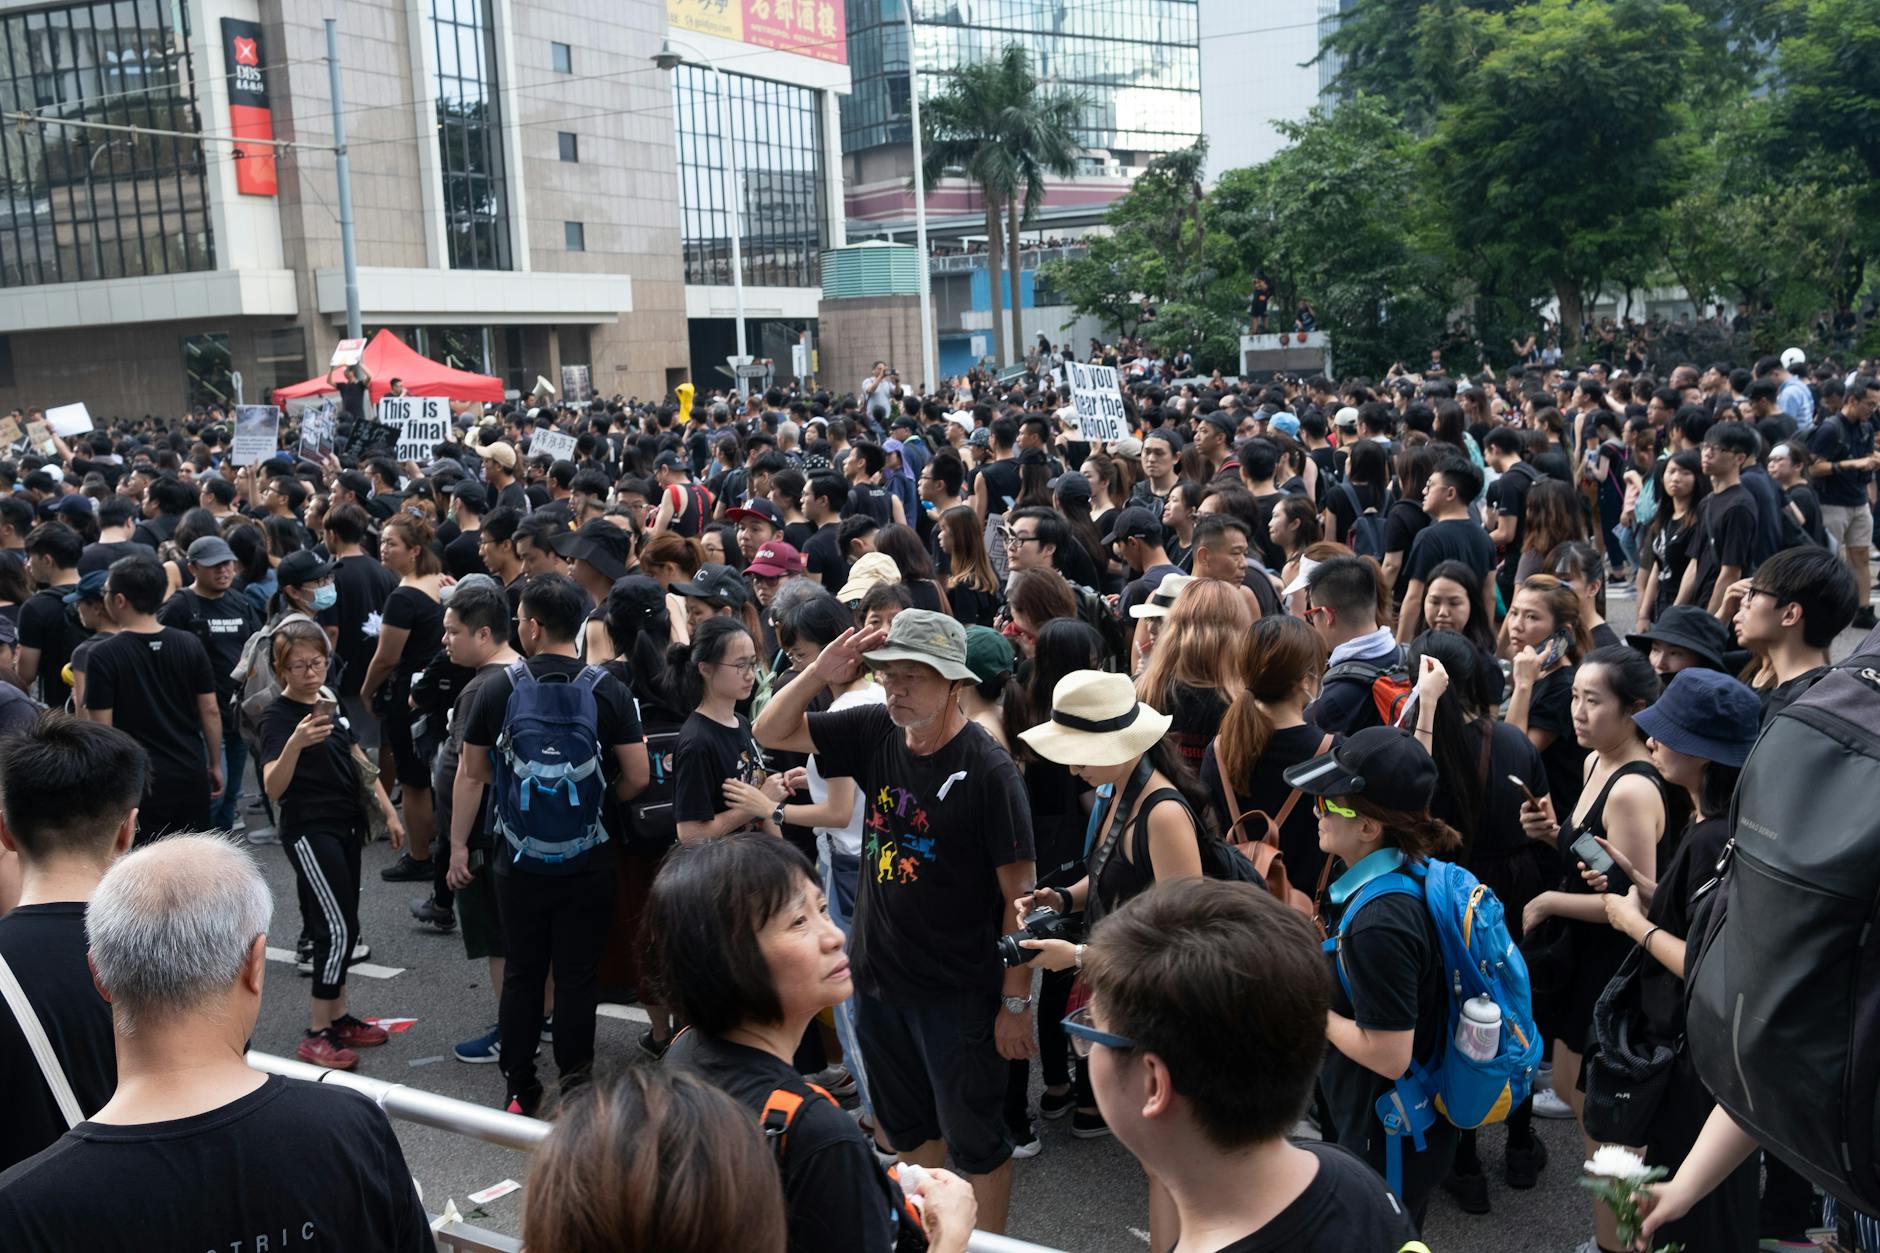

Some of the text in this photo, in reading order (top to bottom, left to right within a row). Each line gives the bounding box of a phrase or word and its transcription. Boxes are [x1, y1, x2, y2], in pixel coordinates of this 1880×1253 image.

[236, 65, 261, 81] DBS
[1072, 363, 1113, 390] Do you
[383, 398, 437, 419] This is
[1100, 393, 1124, 419] the
[407, 420, 447, 440] final
[394, 443, 430, 460] anc
[206, 1221, 314, 1253] TRIC
